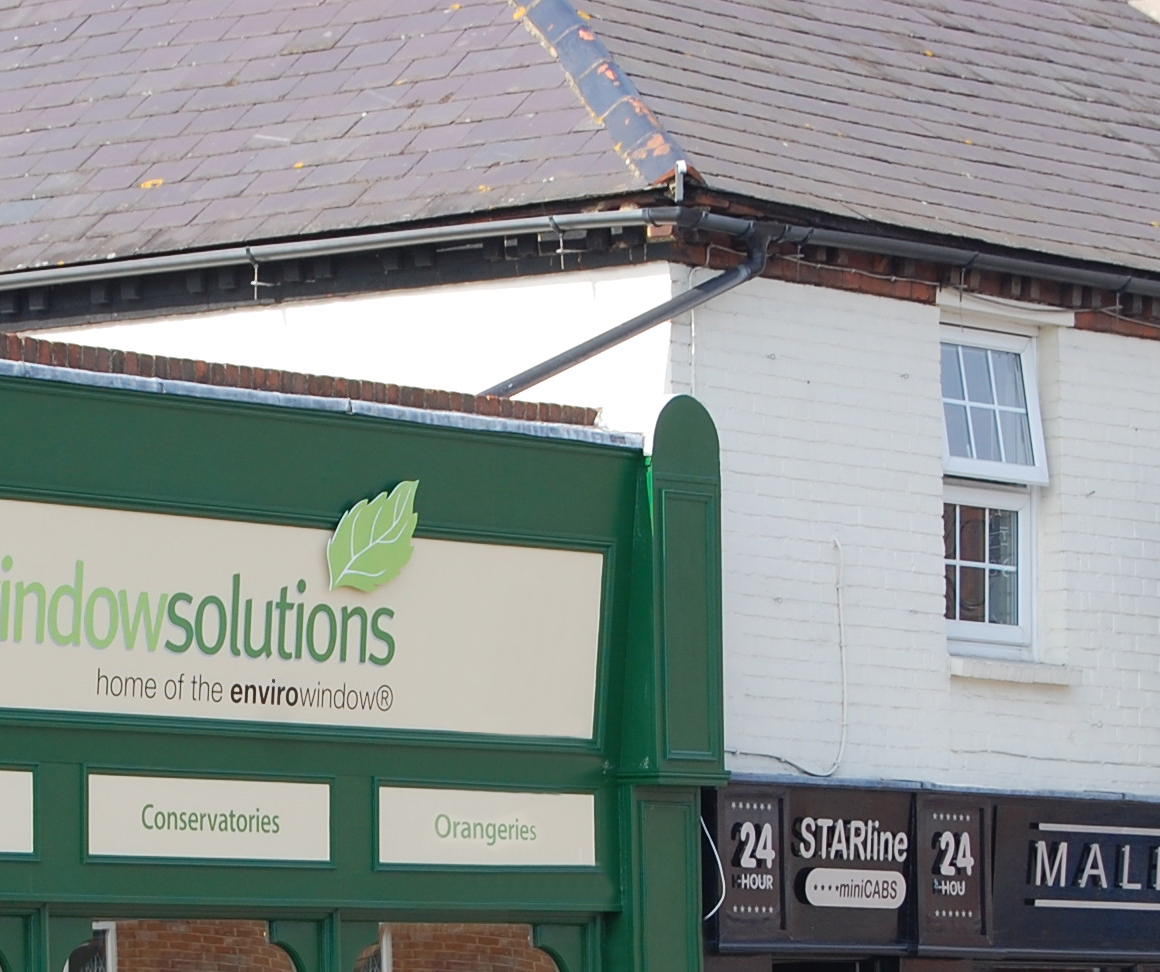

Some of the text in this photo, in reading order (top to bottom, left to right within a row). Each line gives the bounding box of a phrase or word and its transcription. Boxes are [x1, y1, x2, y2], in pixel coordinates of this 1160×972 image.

[96, 667, 157, 700] home
[164, 673, 185, 701] of
[191, 675, 223, 703] the
[141, 804, 281, 834] Conservatories
[434, 813, 538, 846] Orangeries
[741, 821, 776, 869] 24
[800, 817, 908, 863] STARline
[940, 831, 975, 876] 24
[741, 873, 774, 890] HOUR
[1035, 840, 1160, 891] MAL
[840, 878, 898, 900] miniCABS
